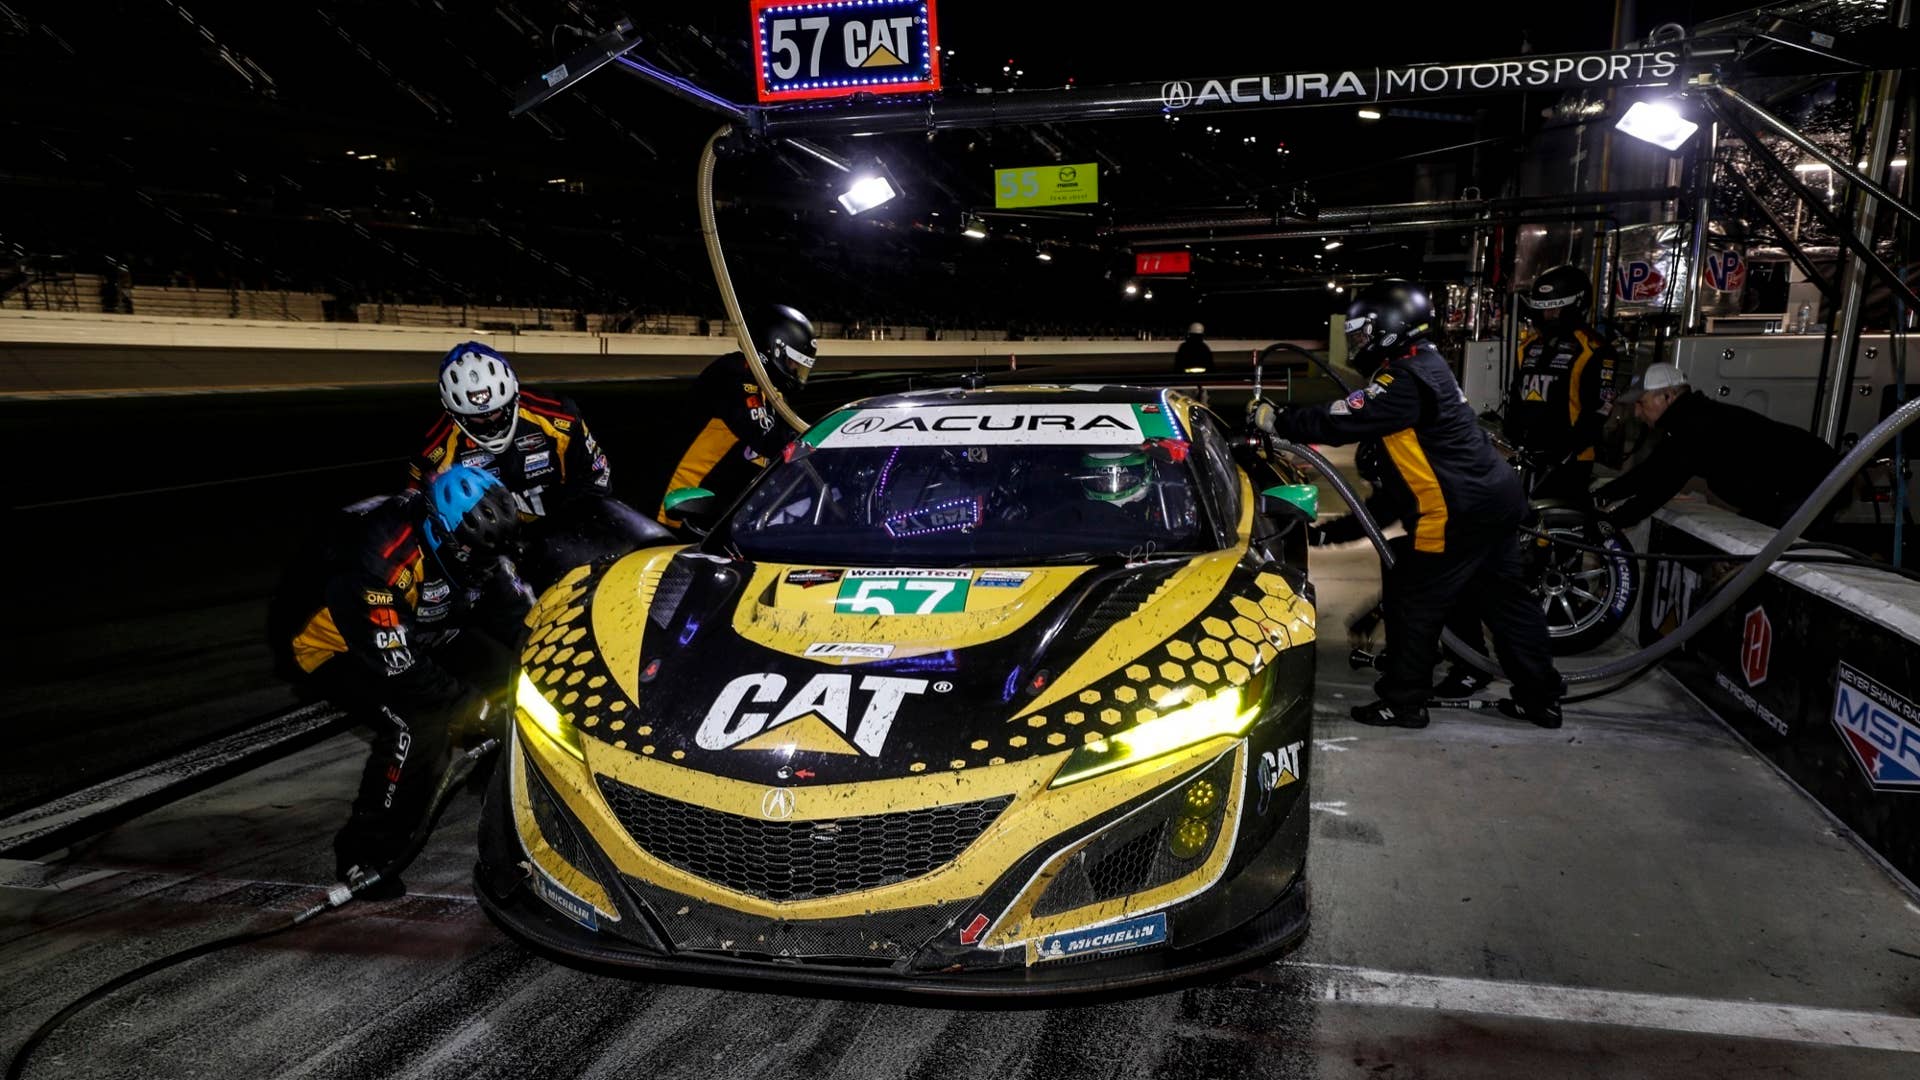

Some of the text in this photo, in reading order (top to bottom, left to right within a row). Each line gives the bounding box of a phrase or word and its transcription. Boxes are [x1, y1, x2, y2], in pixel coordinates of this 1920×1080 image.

[772, 16, 830, 80] 57
[1195, 51, 1677, 106] ACURA MOTORSPORTS
[1001, 171, 1039, 198] 55
[1521, 373, 1553, 403] CAT
[880, 415, 1134, 433] ACURA
[851, 569, 969, 578] WeatherTech
[367, 593, 394, 605] OMP
[850, 579, 957, 615] 57
[1652, 559, 1698, 632] CAT
[376, 625, 408, 649] CAT
[1840, 666, 1869, 692] MEYER
[1869, 683, 1902, 712] SHANK
[1260, 741, 1301, 789] CAT
[548, 888, 590, 920] MICHELIN
[1067, 924, 1155, 951] MICHELIN
